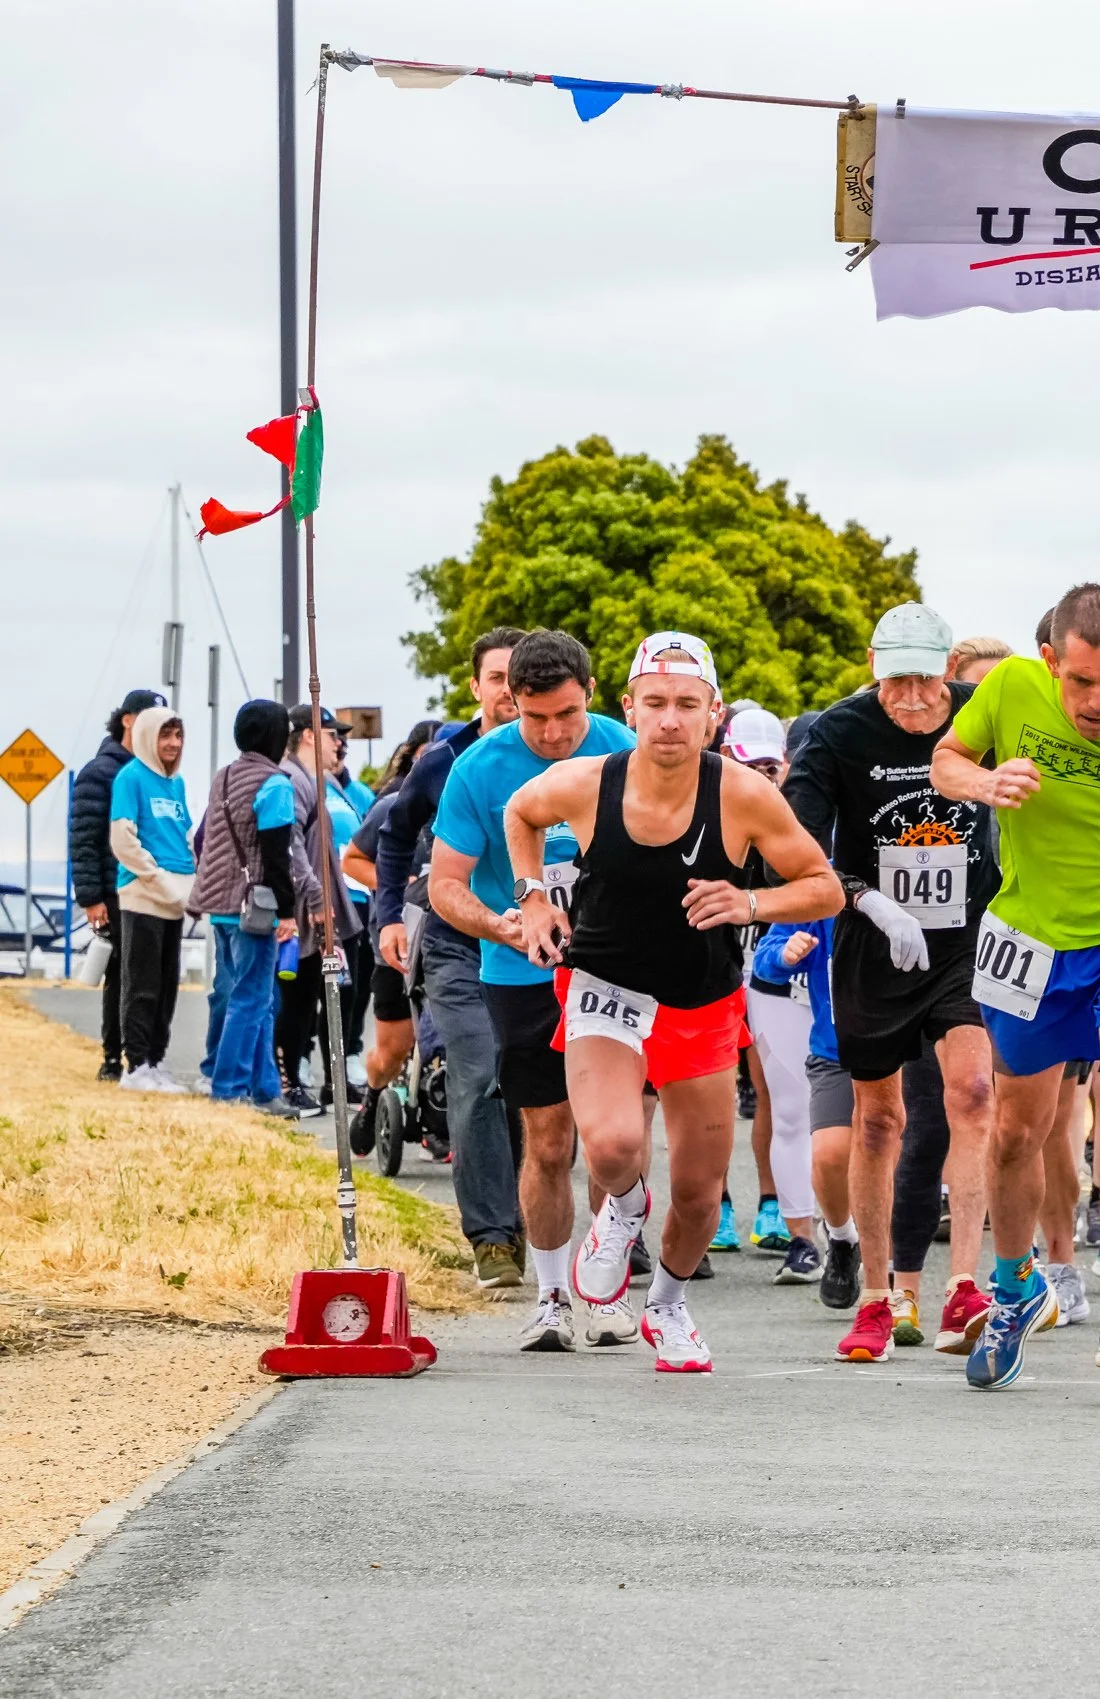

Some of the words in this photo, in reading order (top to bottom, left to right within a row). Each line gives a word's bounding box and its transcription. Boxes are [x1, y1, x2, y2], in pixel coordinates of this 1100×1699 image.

[845, 165, 866, 202] START
[1024, 730, 1041, 742] 2012
[1042, 737, 1069, 752] OHLONE
[886, 767, 908, 775] Sutter
[869, 813, 882, 825] San
[878, 800, 898, 815] Mateo
[897, 790, 922, 803] Rotary
[923, 788, 933, 797] 5K
[893, 868, 952, 905] 049
[977, 931, 1034, 990] 001
[580, 991, 641, 1028] 045
